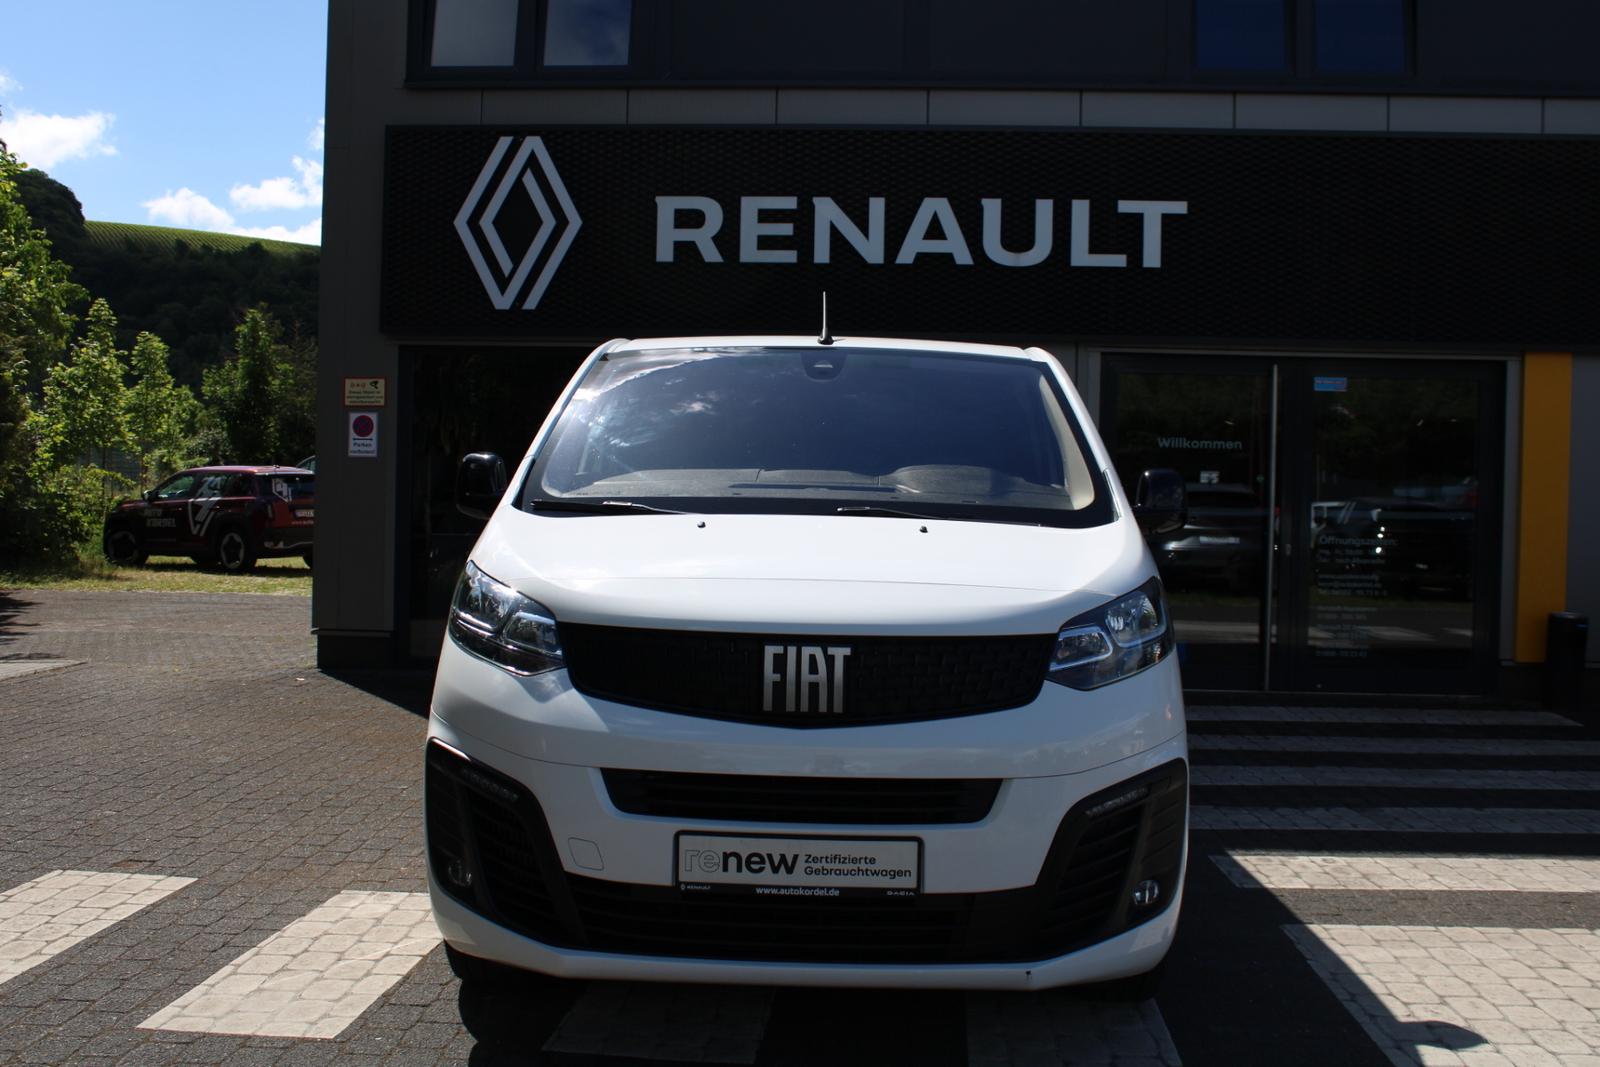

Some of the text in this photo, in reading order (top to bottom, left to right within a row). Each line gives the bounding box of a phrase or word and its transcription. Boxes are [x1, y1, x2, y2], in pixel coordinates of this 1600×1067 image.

[654, 195, 1188, 268] RENAULT
[1157, 436, 1243, 450] Willkommen
[764, 645, 851, 713] FIAT
[684, 849, 800, 875] renew
[804, 854, 876, 865] Zertifizierte
[804, 866, 911, 879] Gebrauchtwagen
[756, 887, 840, 897] www.autokordel.de
